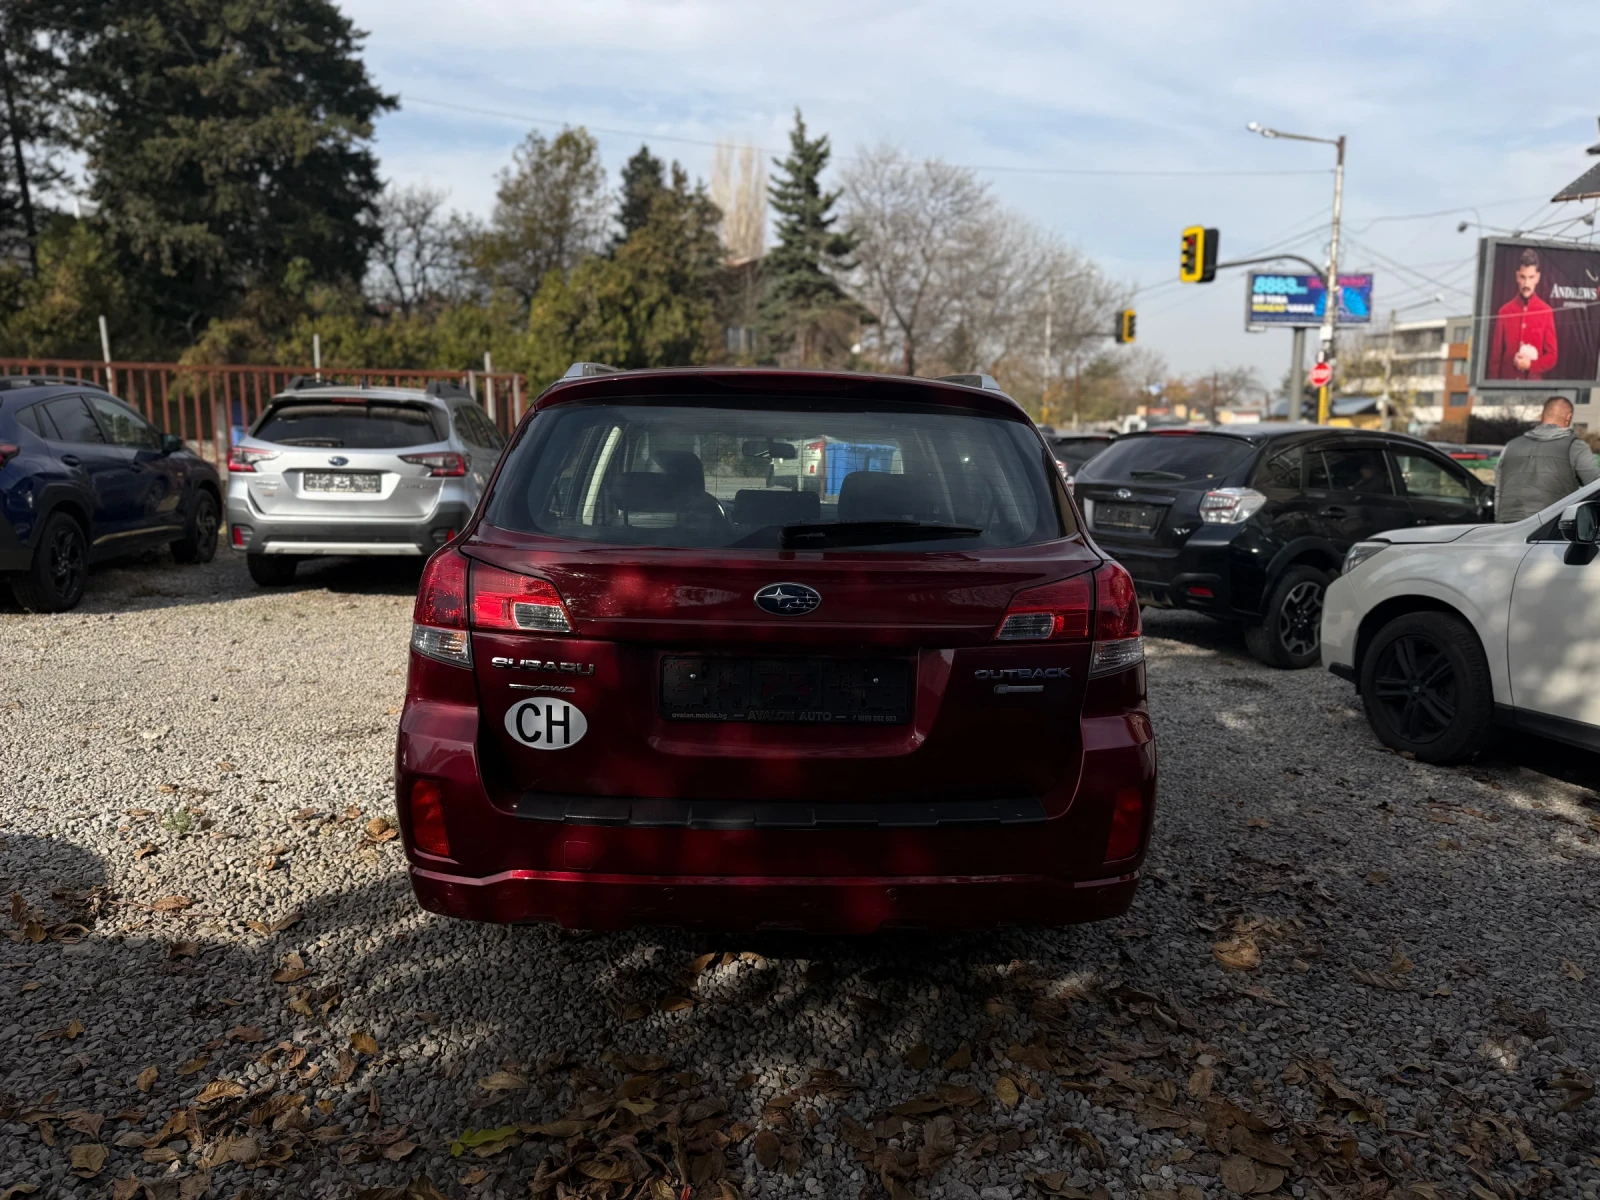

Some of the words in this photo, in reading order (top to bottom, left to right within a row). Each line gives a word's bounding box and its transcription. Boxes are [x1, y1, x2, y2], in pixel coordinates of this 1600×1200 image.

[1549, 282, 1598, 300] ANDREWS
[491, 656, 595, 675] SUBARU
[974, 667, 1072, 680] OUTBACK
[515, 702, 571, 744] CH
[671, 711, 728, 720] avalon.mobile.bg
[747, 710, 795, 721] AVALON
[799, 711, 832, 721] AUTO
